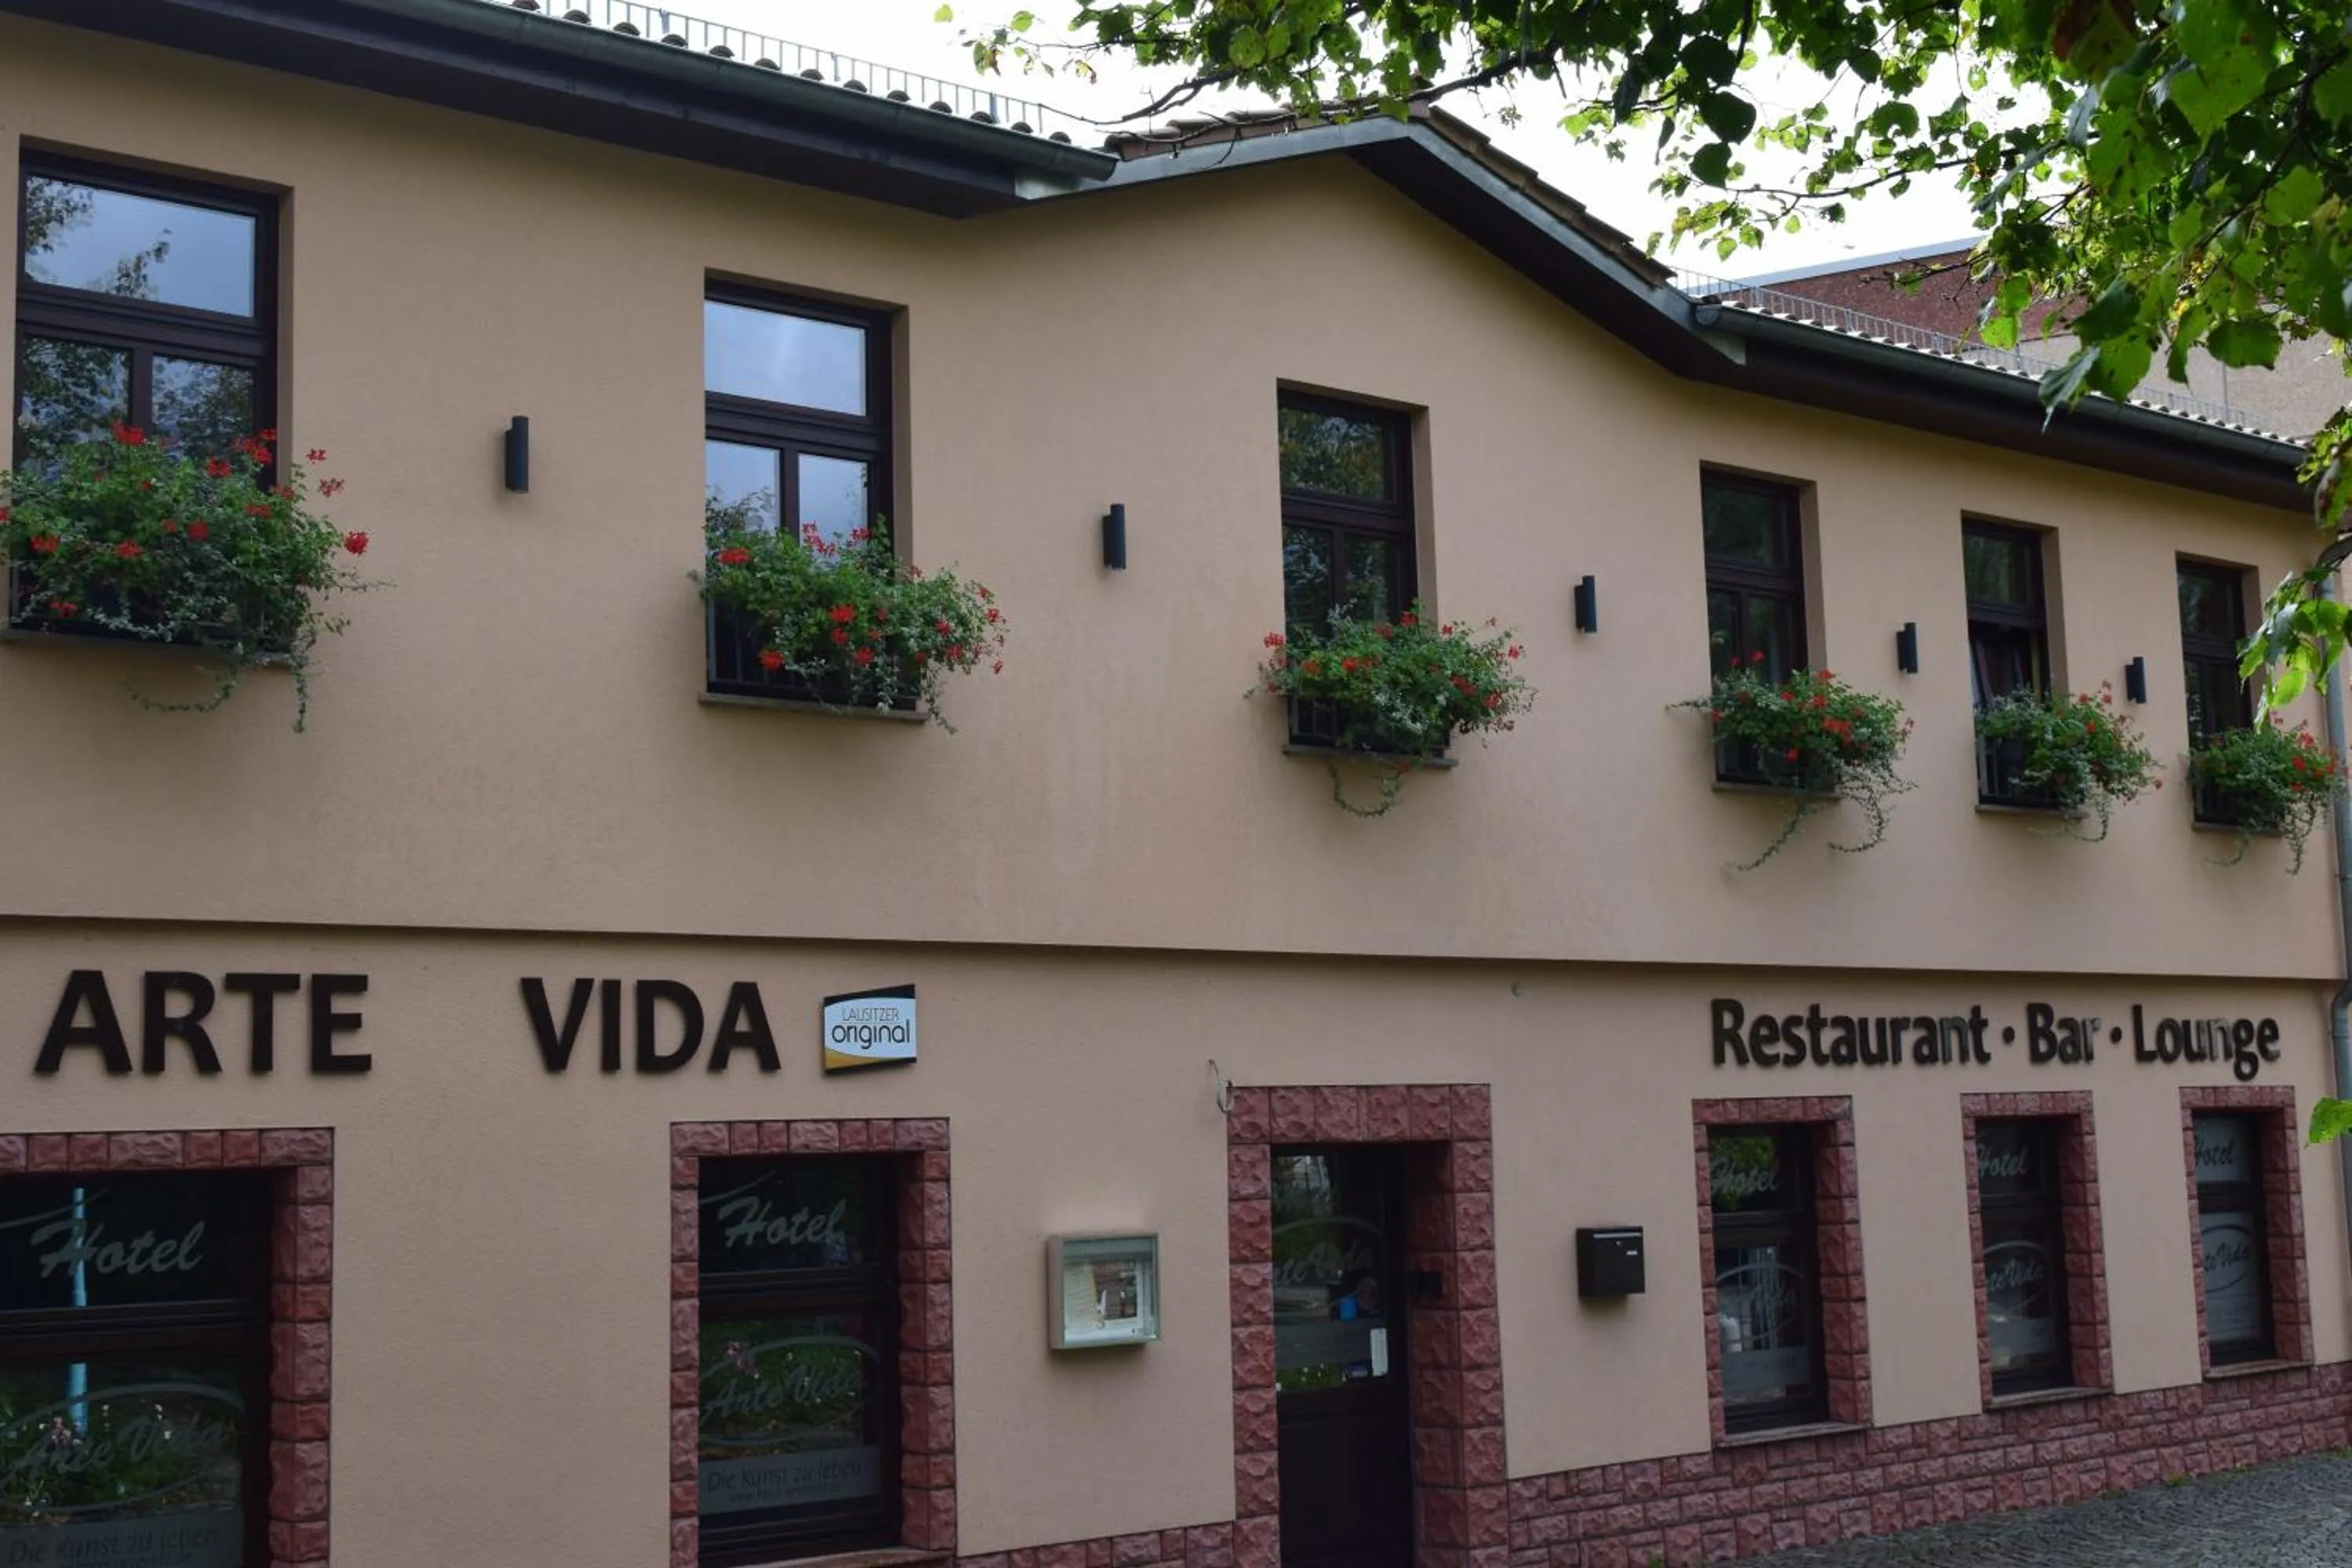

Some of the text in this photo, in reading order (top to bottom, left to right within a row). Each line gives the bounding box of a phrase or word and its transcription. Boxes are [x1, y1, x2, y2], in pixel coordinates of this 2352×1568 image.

[34, 969, 781, 1074] ARTE VIDA
[832, 1018, 910, 1050] original
[841, 1007, 900, 1022] LAUSITZER
[1710, 998, 2281, 1082] Restaurant Bar Lounge
[29, 1218, 205, 1279] Hotel
[717, 1195, 848, 1249] Hotel
